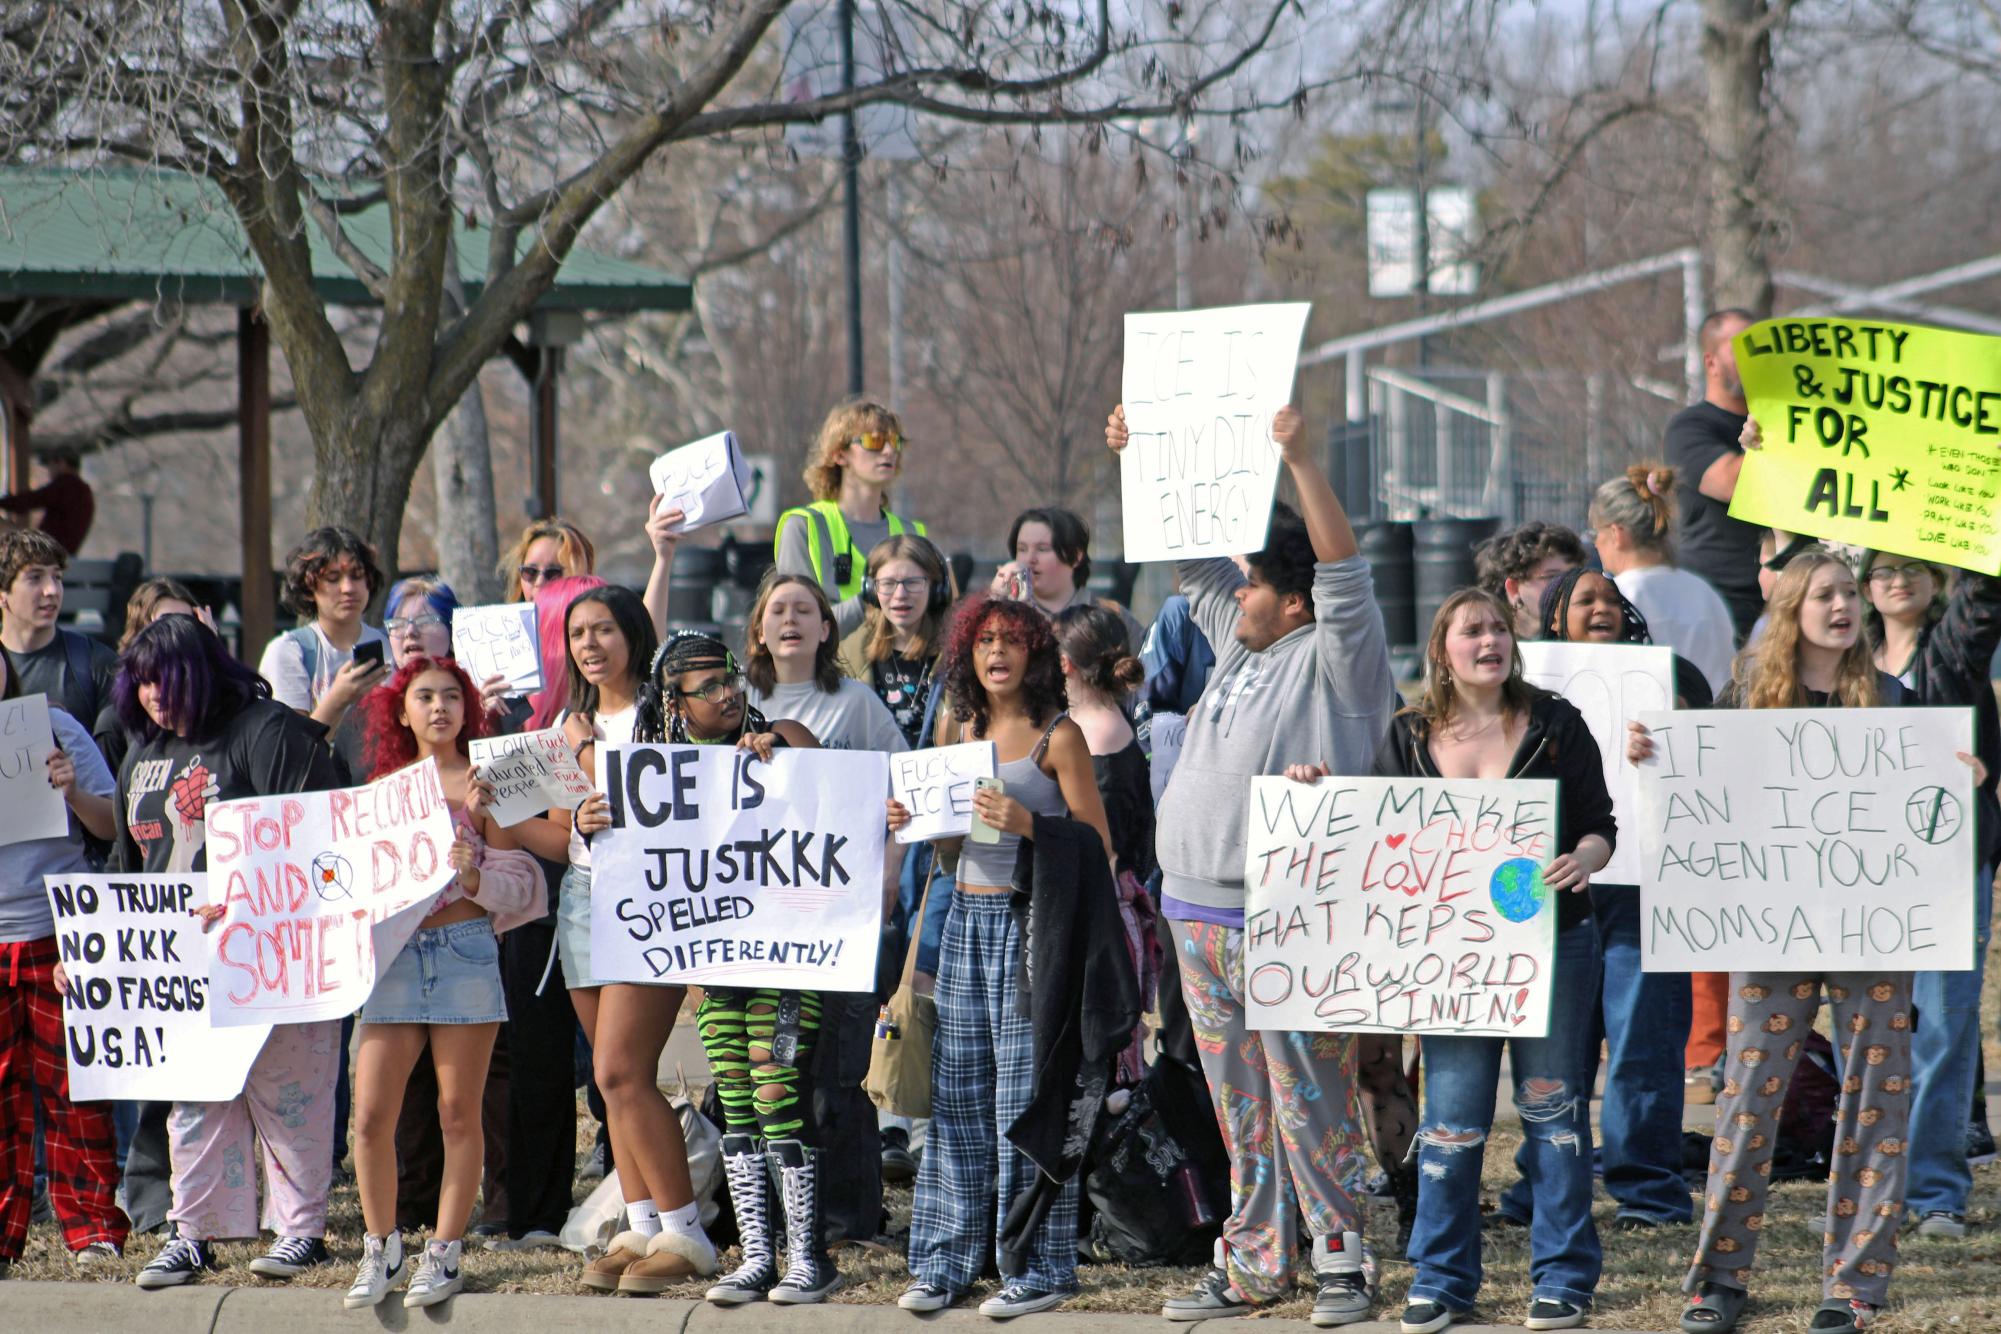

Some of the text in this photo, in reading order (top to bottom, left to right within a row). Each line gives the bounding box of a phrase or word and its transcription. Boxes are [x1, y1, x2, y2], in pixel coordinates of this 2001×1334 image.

[1743, 323, 1909, 363] LIBERTY
[1792, 364, 2001, 435] & JUSTICE
[1128, 423, 1206, 482] TINY
[1787, 405, 1870, 458] FOR
[472, 735, 534, 760] I LOVE
[901, 755, 959, 787] FUCK
[1652, 725, 1716, 779] IF
[606, 748, 765, 829] ICE IS
[905, 781, 973, 818] ICE
[1260, 786, 1549, 844] WE MAKE
[1663, 785, 1887, 836] AN ICE
[223, 831, 439, 923] AND DO
[643, 828, 850, 893] JUST KKK
[1258, 842, 1350, 895] THE
[1658, 838, 1918, 888] AGENT YOUR
[52, 884, 98, 918] NO
[616, 896, 755, 941] SPELLED
[1246, 898, 1495, 952] THAT KEPS
[62, 927, 181, 963] NO KKK
[1841, 904, 1937, 957] HOE
[642, 938, 843, 977] DIFFERENTLY!
[1250, 952, 1539, 1006] OUR WORLD
[67, 974, 112, 1011] NO
